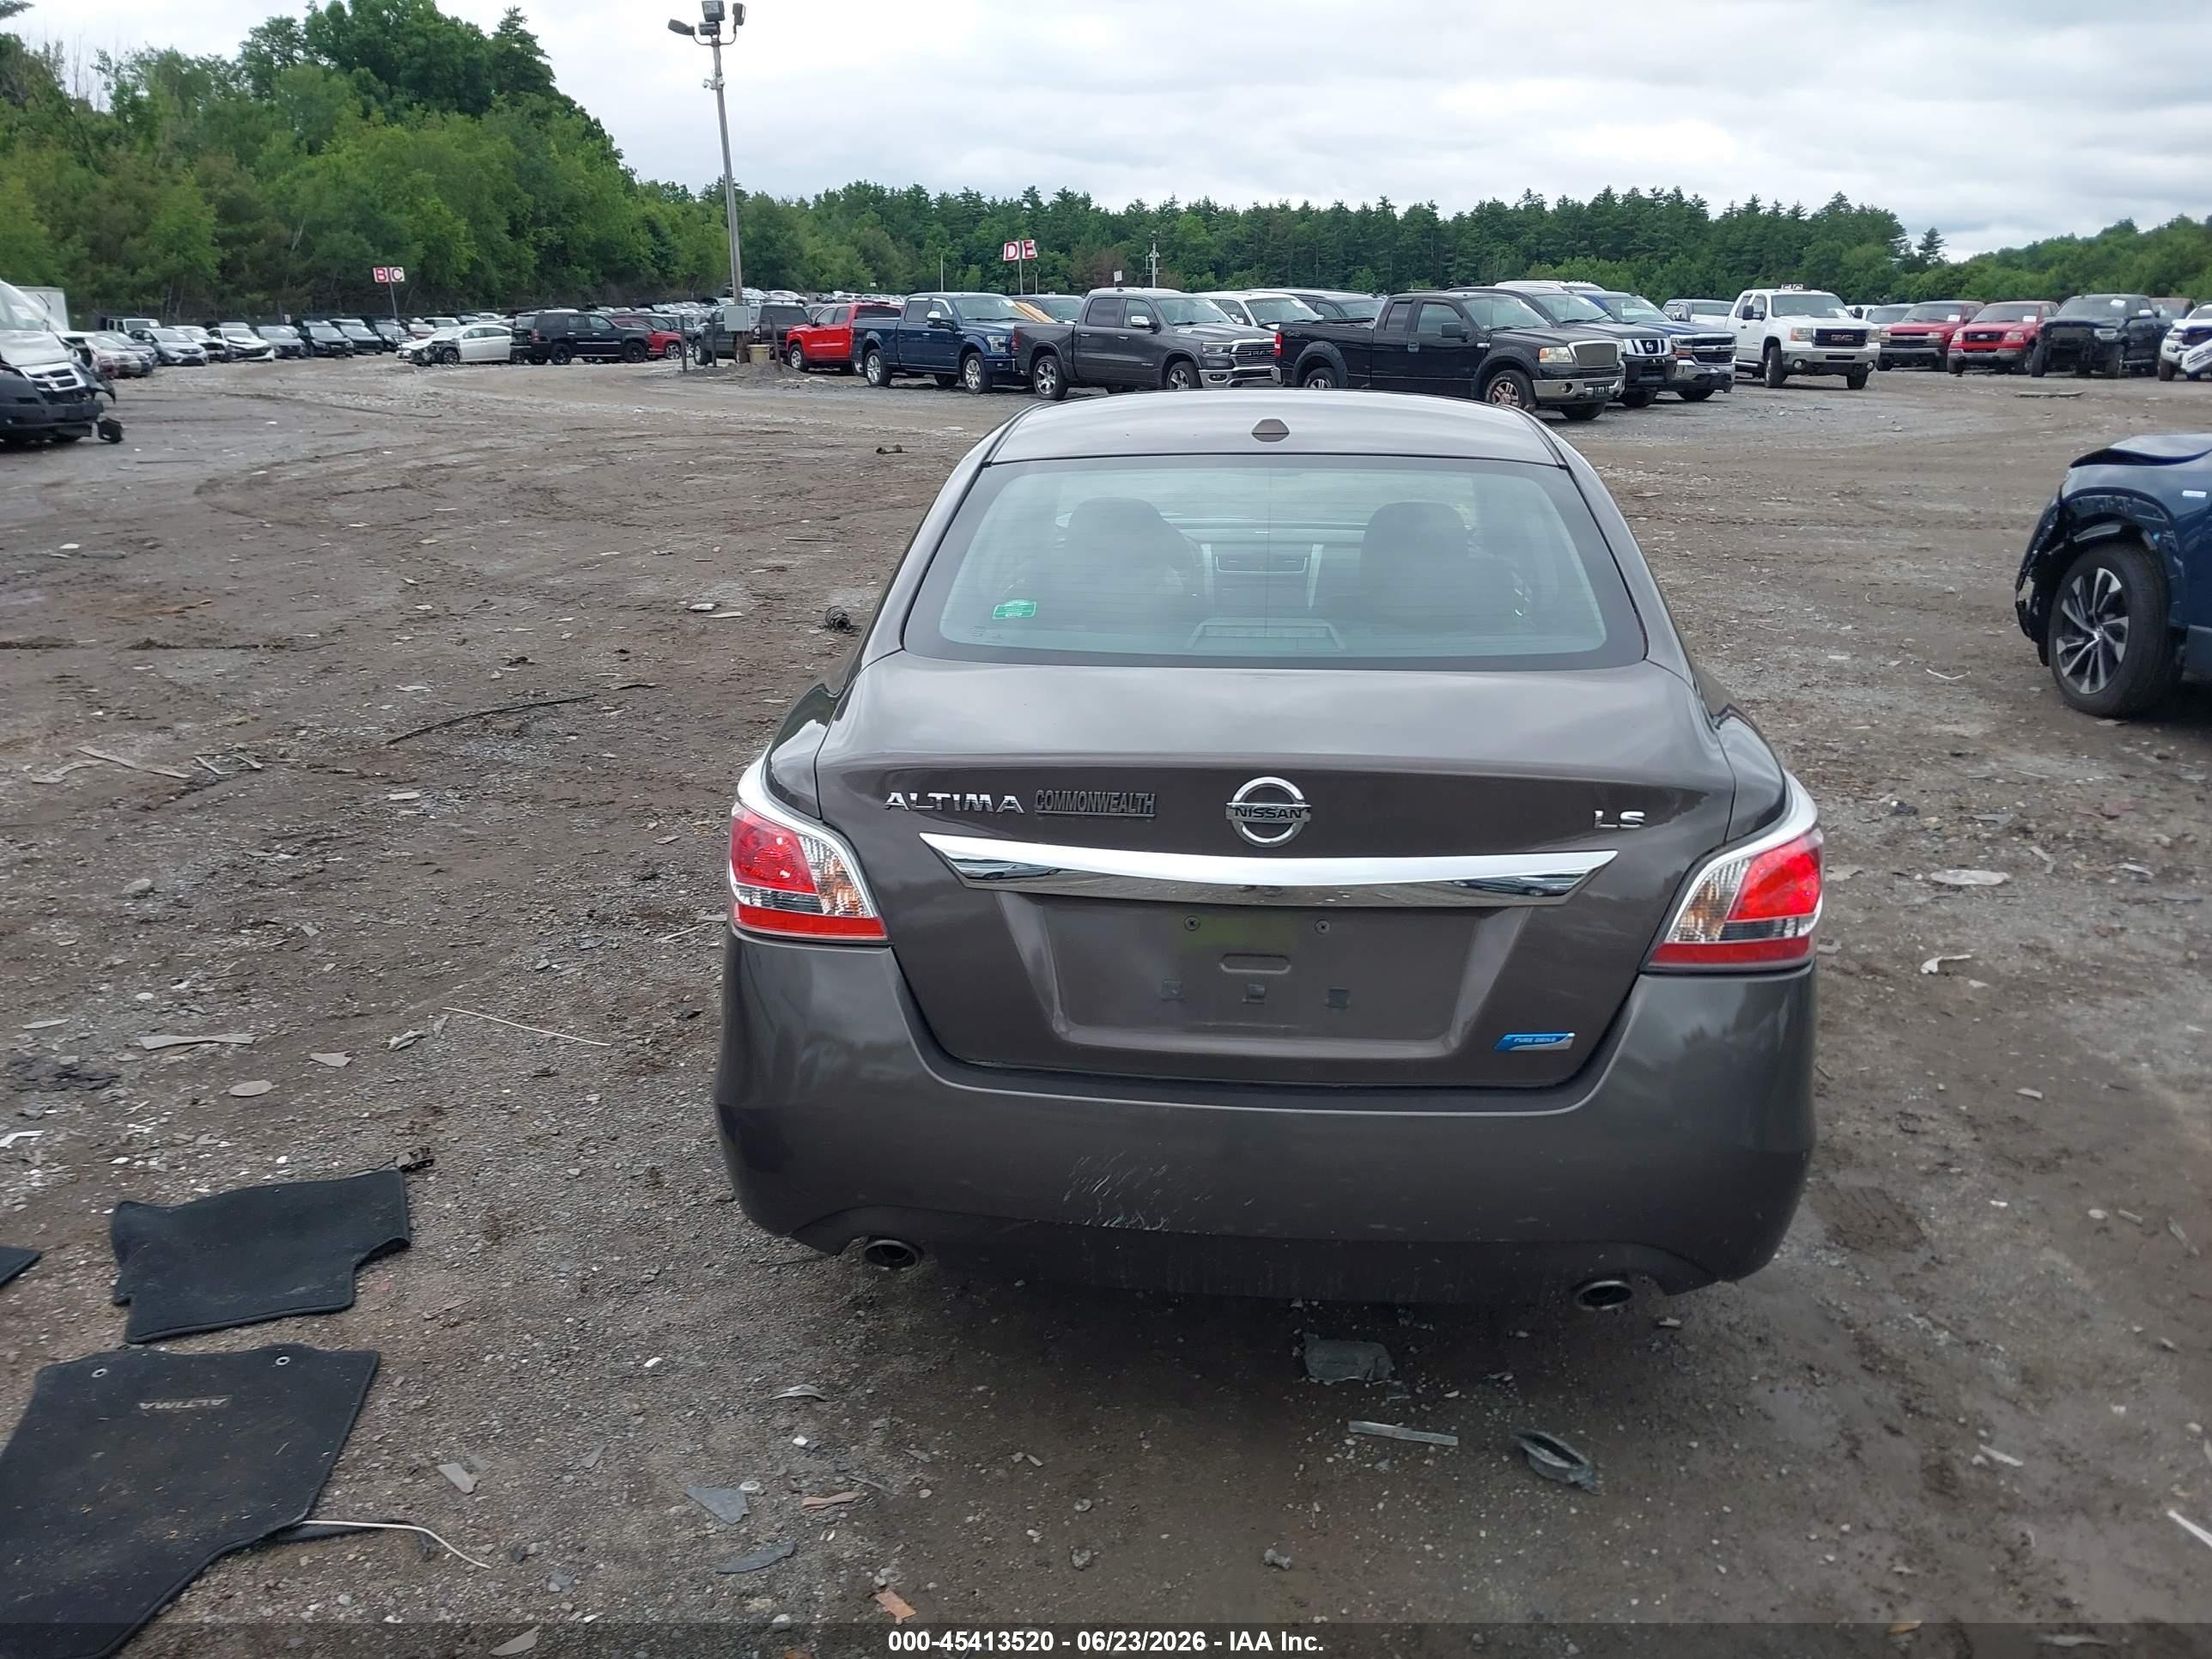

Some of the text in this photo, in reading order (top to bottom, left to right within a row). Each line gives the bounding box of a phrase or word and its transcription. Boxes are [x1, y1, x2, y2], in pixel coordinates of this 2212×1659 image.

[1006, 240, 1036, 259] D E
[376, 268, 404, 282] B C
[884, 792, 1025, 814] ALTIMA
[1036, 790, 1156, 814] COMMONWEALTH
[1234, 807, 1303, 819] NISSAN
[1594, 810, 1645, 830] LS
[139, 1397, 228, 1410] ALTIMA
